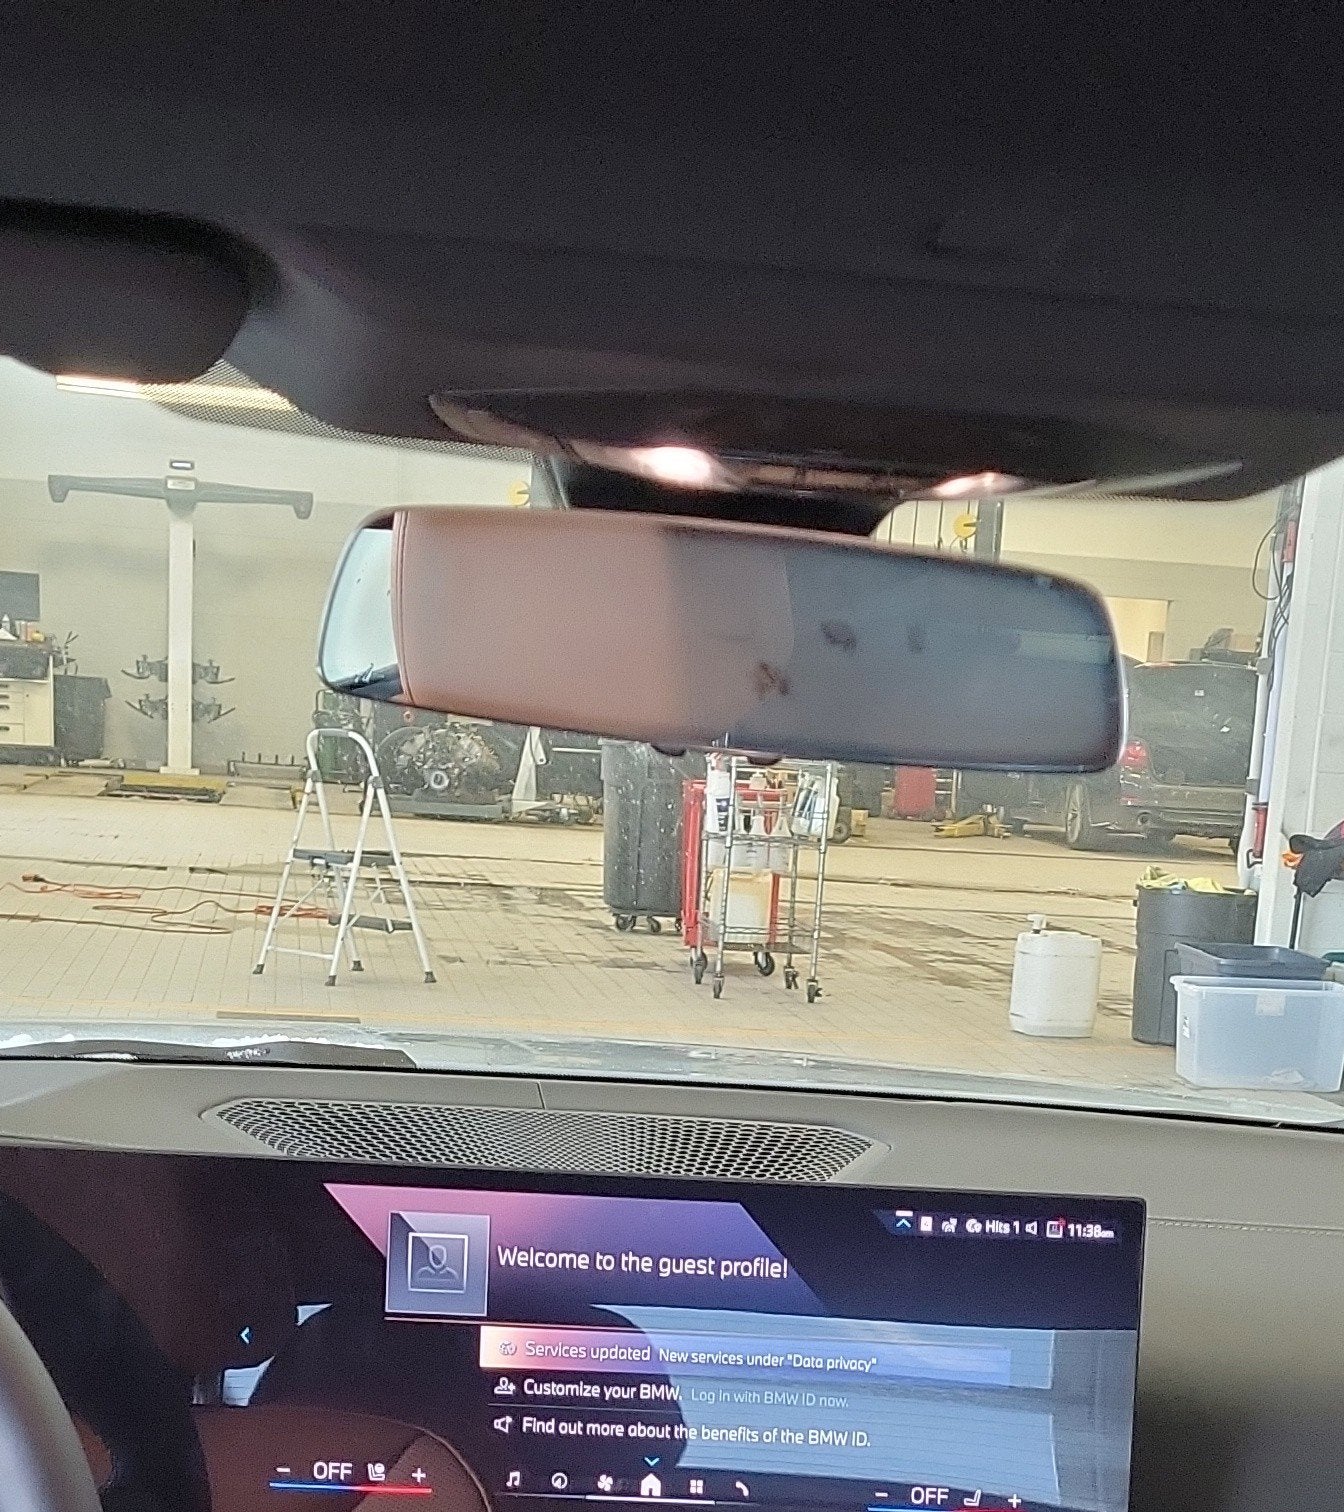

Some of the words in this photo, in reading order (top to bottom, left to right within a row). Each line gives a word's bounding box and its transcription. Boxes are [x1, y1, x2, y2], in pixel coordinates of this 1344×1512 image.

[497, 1245, 590, 1270] Welcome
[595, 1252, 615, 1271] to
[621, 1251, 653, 1273] the
[659, 1256, 716, 1278] guest
[720, 1257, 789, 1280] profile!
[525, 1340, 587, 1359] Services
[591, 1345, 651, 1363] updated
[659, 1347, 689, 1363] New
[691, 1350, 744, 1366] services
[747, 1353, 785, 1368] under
[787, 1353, 824, 1370] "Data
[826, 1355, 877, 1373] privacy"
[523, 1378, 601, 1398] Customize
[604, 1385, 637, 1402] your
[639, 1383, 683, 1401] BMW.
[691, 1387, 716, 1405] Log
[733, 1390, 761, 1404] with
[764, 1392, 798, 1406] BMW
[801, 1393, 817, 1407] ID
[522, 1416, 556, 1434] Find
[558, 1419, 584, 1436] out
[587, 1421, 625, 1438] more
[628, 1421, 671, 1440] about
[674, 1423, 698, 1440] the
[701, 1425, 760, 1443] benefits
[762, 1426, 779, 1444] of
[780, 1428, 806, 1445] the
[808, 1430, 848, 1447] BMW
[852, 1430, 872, 1448] ID.
[313, 1461, 353, 1481] OFF
[910, 1486, 950, 1506] OFF
